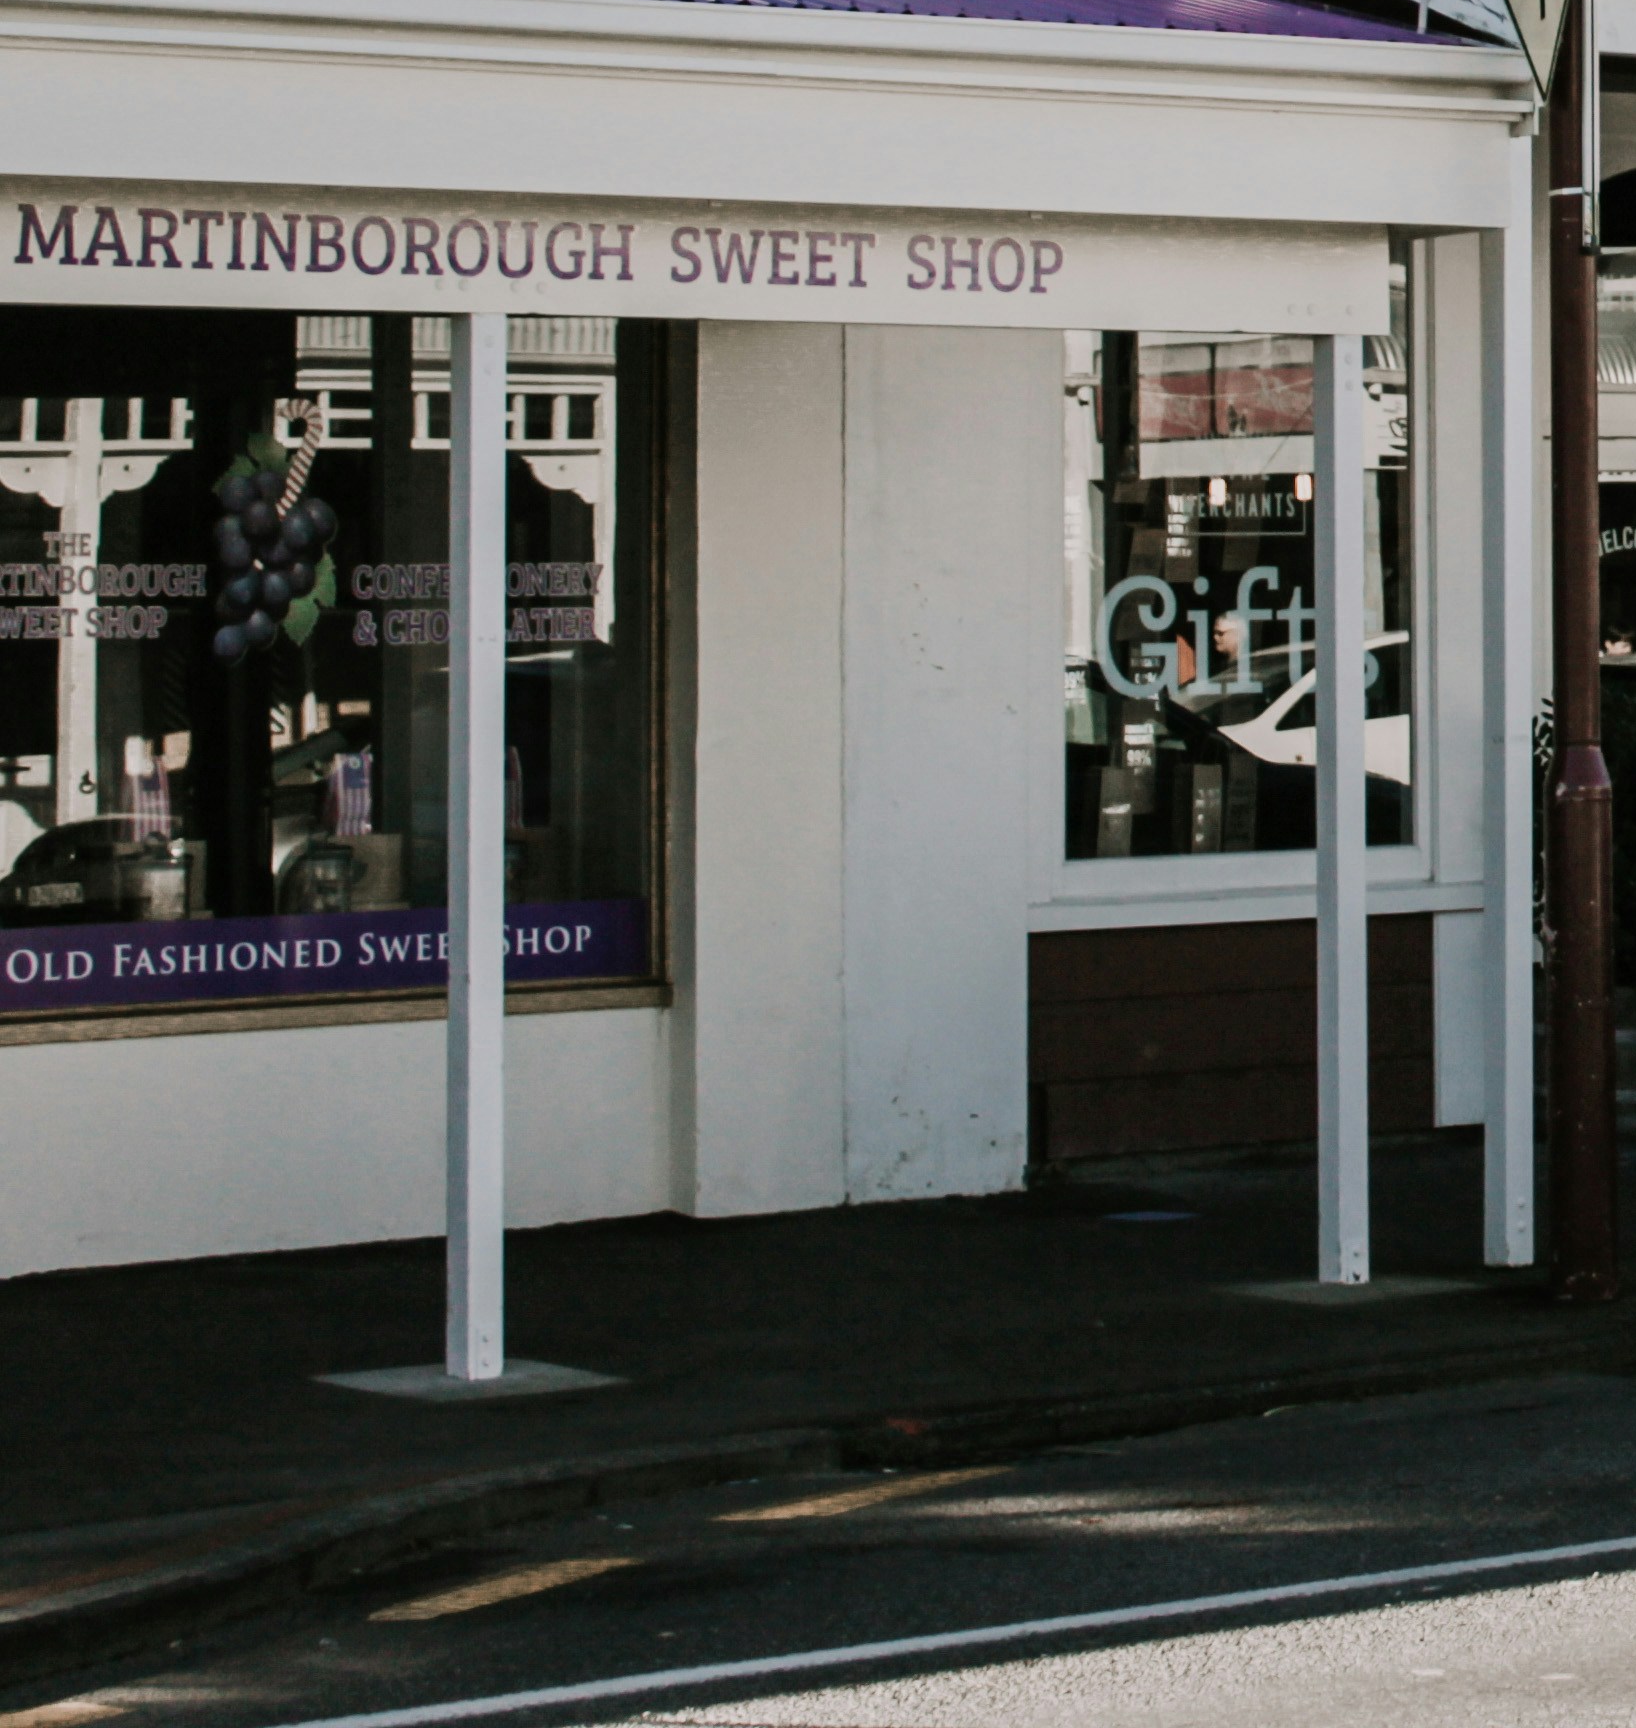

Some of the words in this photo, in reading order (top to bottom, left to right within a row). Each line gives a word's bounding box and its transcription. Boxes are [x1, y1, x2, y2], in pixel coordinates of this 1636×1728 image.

[13, 202, 635, 283] MARTINBOROUGH
[669, 226, 876, 289] SWEET
[906, 234, 1065, 295] SHOP
[1183, 492, 1296, 518] ERCHANTS
[42, 531, 91, 558] THE
[0, 562, 207, 597] TINBOROUGH
[351, 562, 604, 600] CONFEONERY
[85, 605, 168, 640] SHOP
[352, 609, 378, 646] &
[384, 606, 596, 645] CHOATIER
[1096, 566, 1380, 700] Gift
[358, 931, 449, 966] SWE
